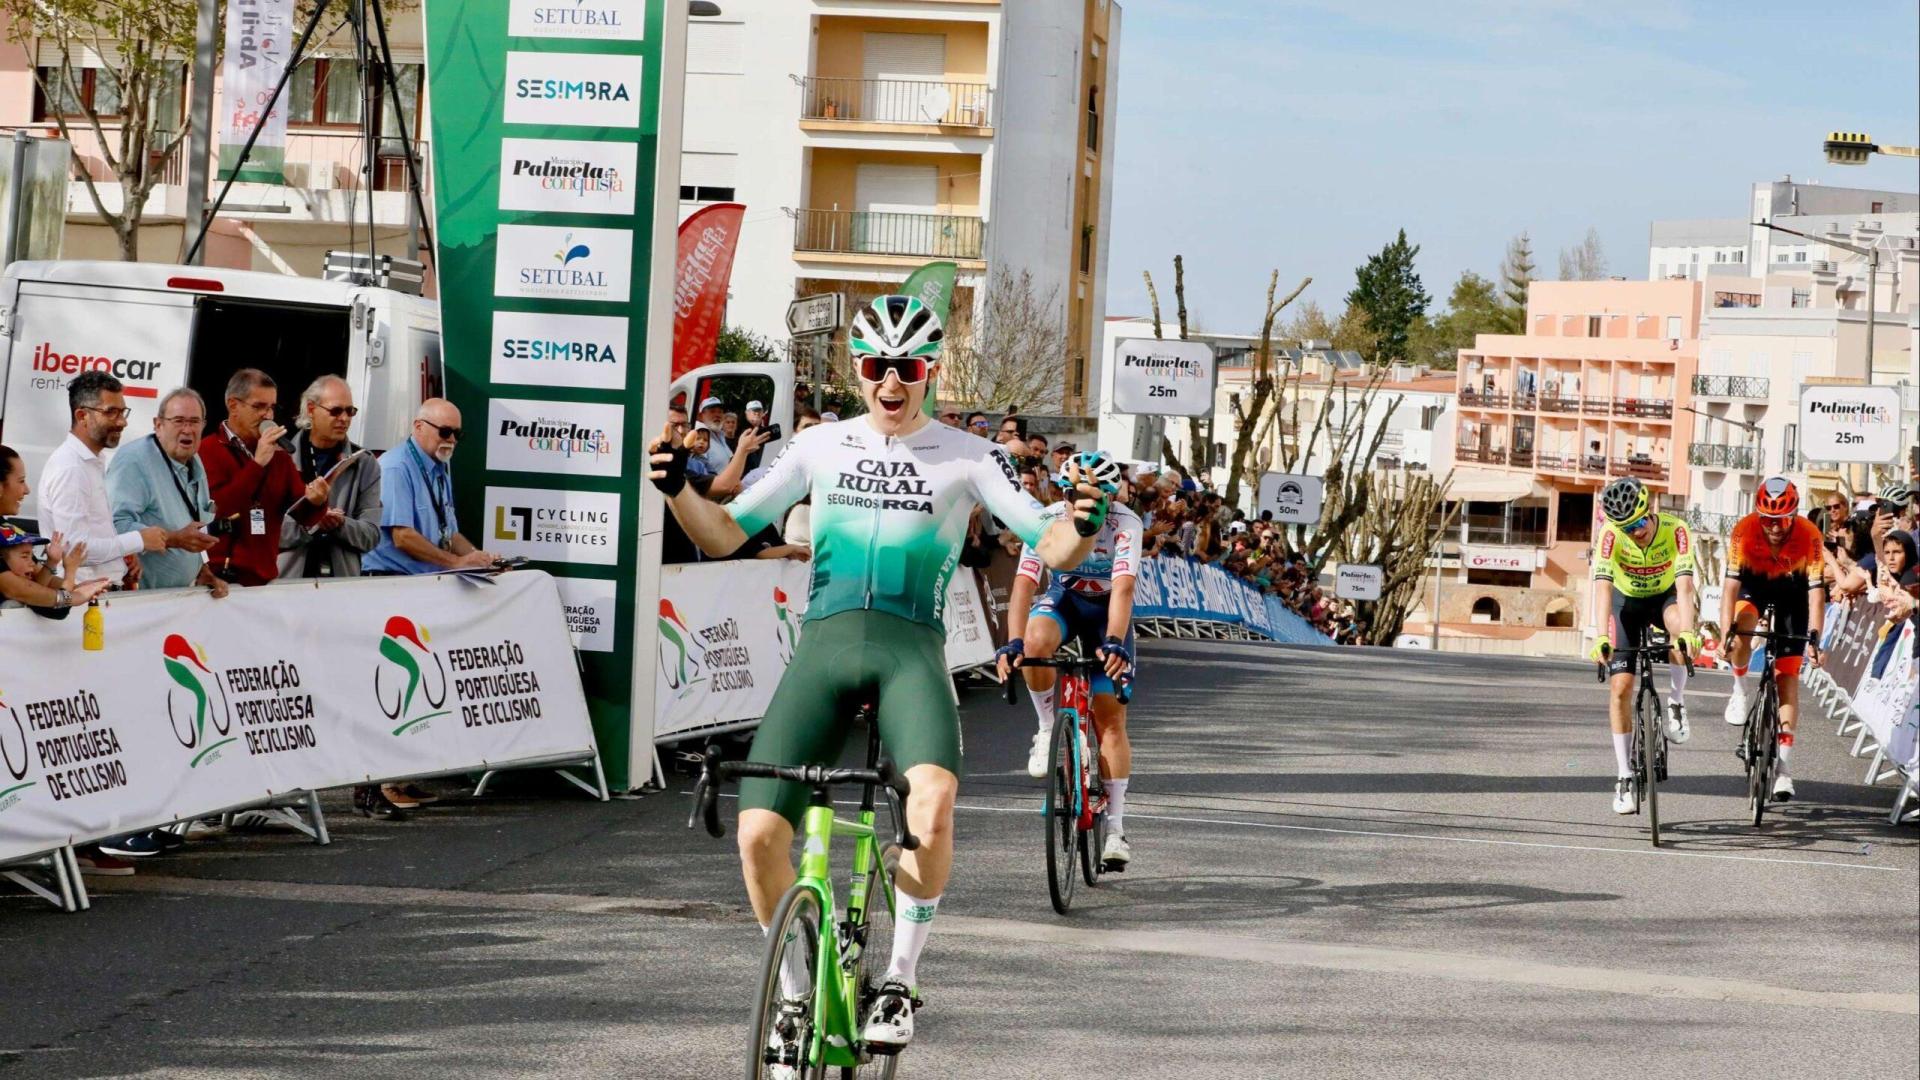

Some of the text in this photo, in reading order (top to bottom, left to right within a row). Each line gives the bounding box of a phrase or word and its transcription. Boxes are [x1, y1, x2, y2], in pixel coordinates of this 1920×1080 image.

[513, 160, 604, 179] Palmela
[542, 172, 624, 199] conquista
[673, 240, 709, 314] mela
[33, 342, 161, 380] iberocar
[1125, 355, 1190, 369] Palmela
[1148, 385, 1177, 397] 25m
[1810, 402, 1876, 415] Palmela
[500, 420, 590, 440] Palmela
[1835, 432, 1864, 444] 25m
[529, 434, 611, 461] conquista
[856, 459, 920, 478] CAJA
[990, 449, 1021, 493] RGA
[836, 472, 933, 496] RURAL
[827, 493, 934, 514] SEGUROS RGA
[1279, 506, 1299, 515] 50m
[536, 508, 608, 523] CYCLING
[536, 532, 607, 546] SERVICES
[563, 605, 595, 616] ERAÇÃO
[566, 615, 600, 625] UGUESA
[448, 640, 524, 672] FEDERAÇÃO
[704, 646, 750, 669] PORTUGUESA
[226, 659, 300, 696] FEDERAÇÃO
[455, 671, 541, 701] PORTUGUESA
[718, 669, 753, 690] CICLISMO
[26, 689, 101, 731] FEDERAÇÃO
[235, 694, 315, 726] PORTUGUESA
[462, 697, 541, 728] DE CICLISMO
[36, 727, 122, 768] PORTUGUESA
[46, 759, 127, 801] DE CICLISMO
